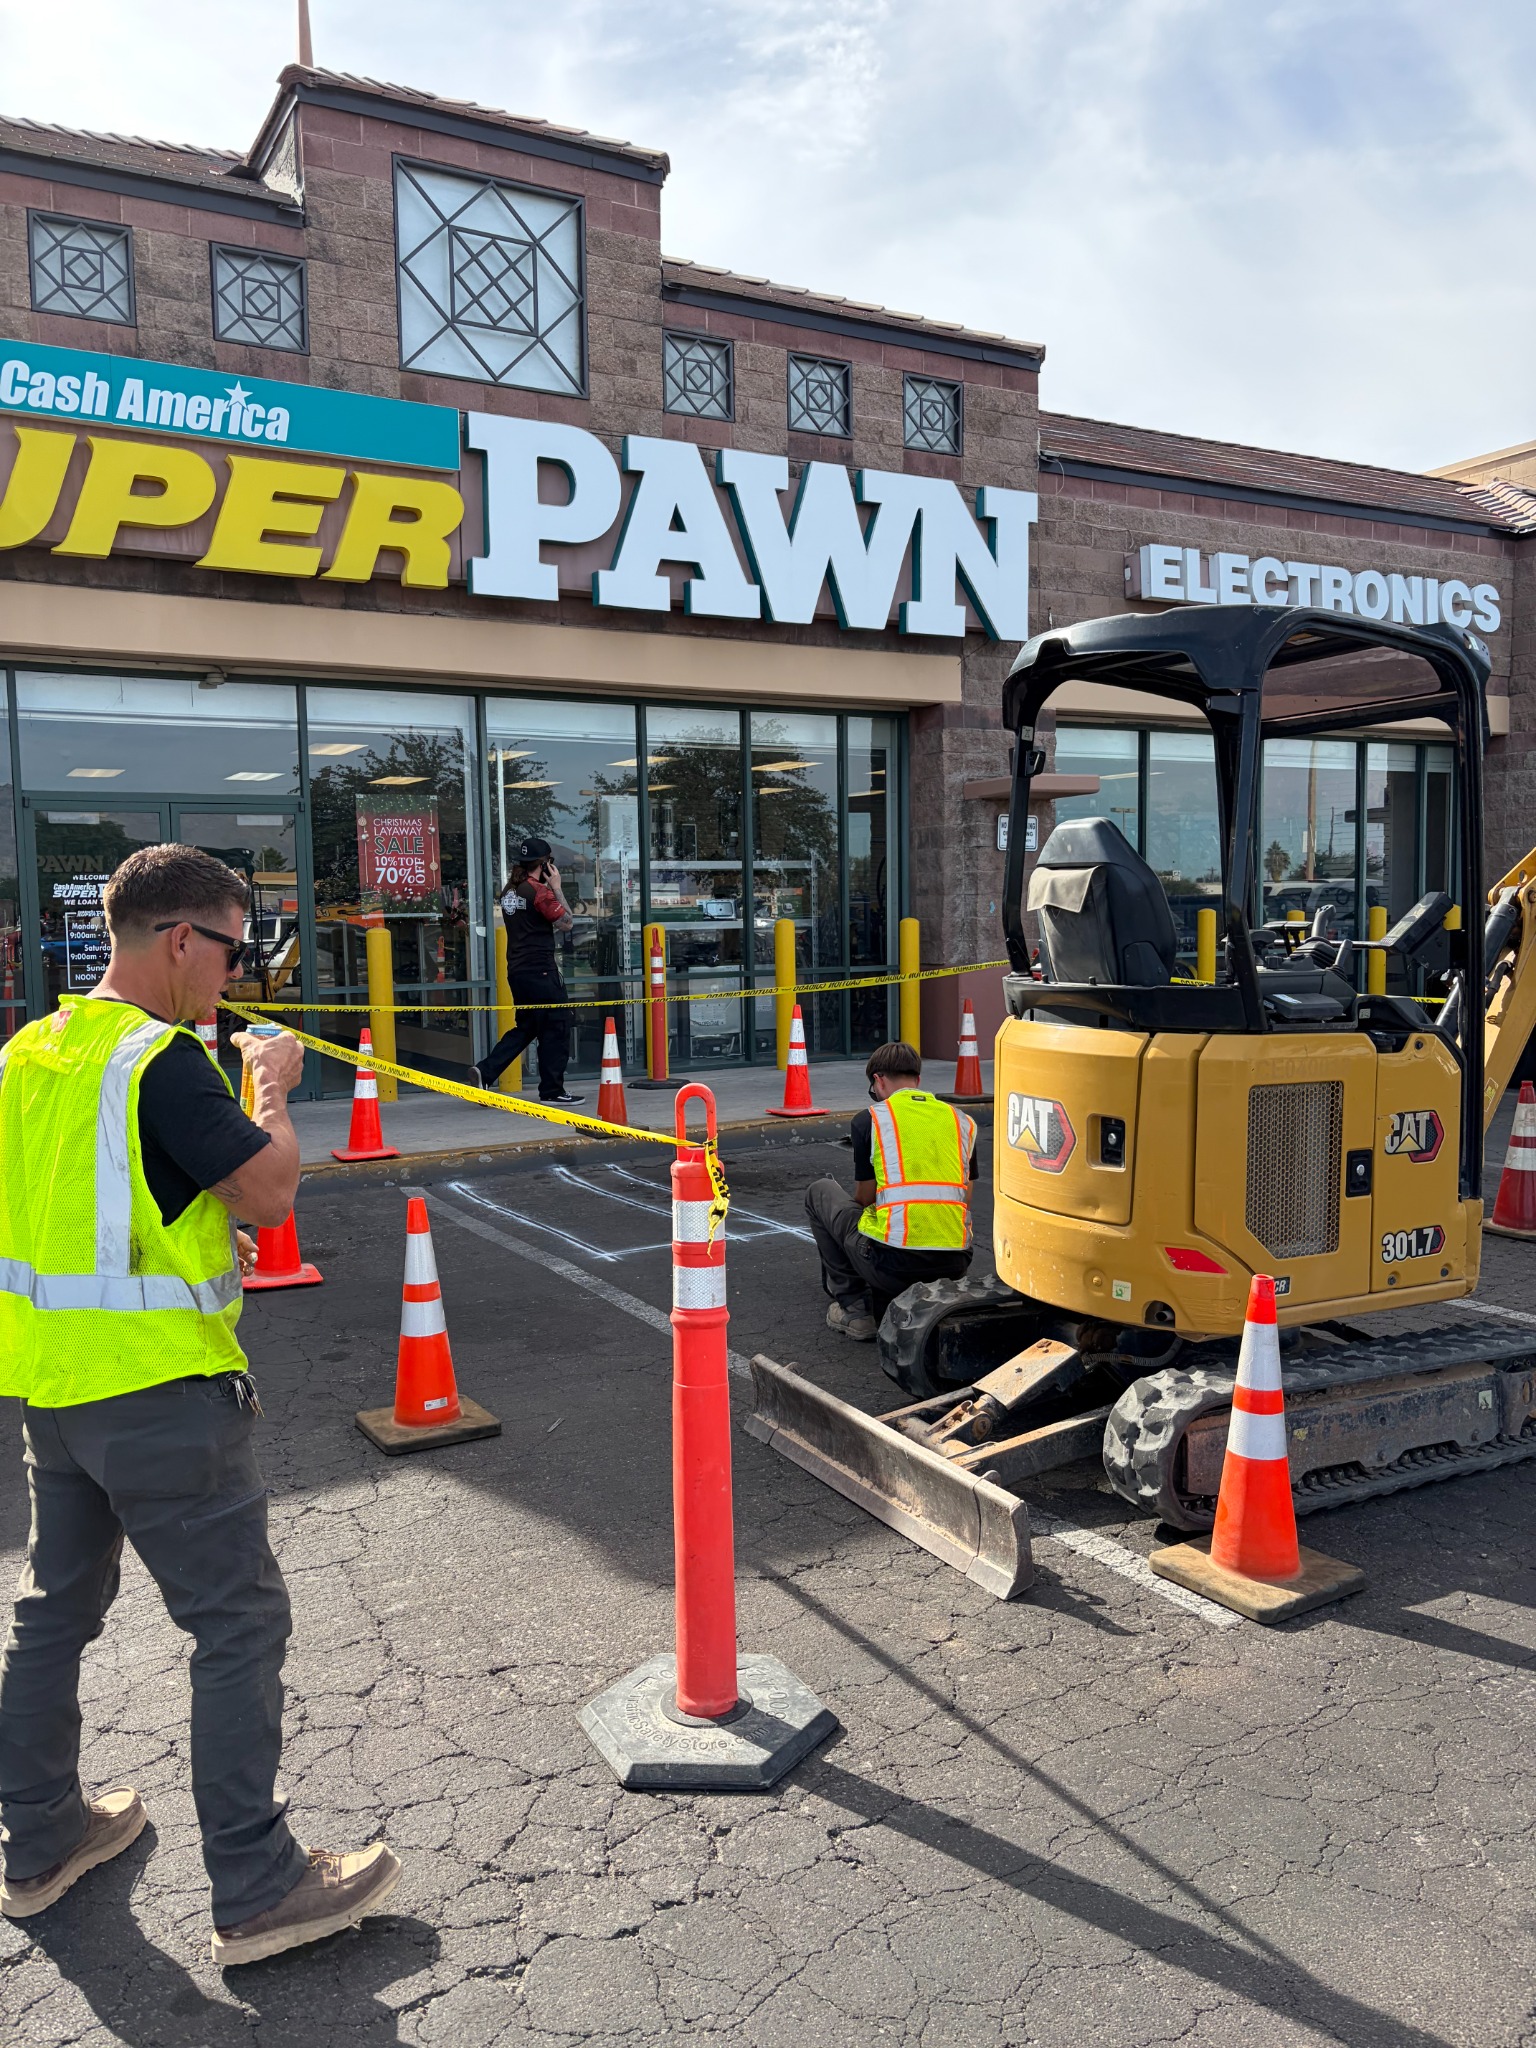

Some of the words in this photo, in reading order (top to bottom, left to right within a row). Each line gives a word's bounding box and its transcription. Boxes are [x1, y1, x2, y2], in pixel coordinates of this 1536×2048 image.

[1, 359, 108, 417] Cash
[115, 379, 291, 442] America
[465, 411, 1038, 641] PAWN
[1140, 543, 1501, 633] ELECTRONICS
[373, 818, 423, 827] CHRISTMAS
[373, 827, 422, 836] LAYAWAY
[374, 837, 425, 855] SALE
[374, 856, 398, 867] 10%
[398, 857, 414, 866] TO
[375, 867, 415, 884] 70%
[415, 857, 425, 884] OFF
[52, 890, 97, 898] SUPER
[71, 923, 99, 932] Monday
[84, 944, 112, 952] Saturda
[86, 964, 108, 972] Sund
[1007, 1093, 1054, 1154] CAT
[1385, 1111, 1430, 1154] CAT
[1382, 1227, 1435, 1262] 301.7
[1274, 1279, 1287, 1292] CR
[624, 1694, 769, 1750] TrafficSafetyStore.com
